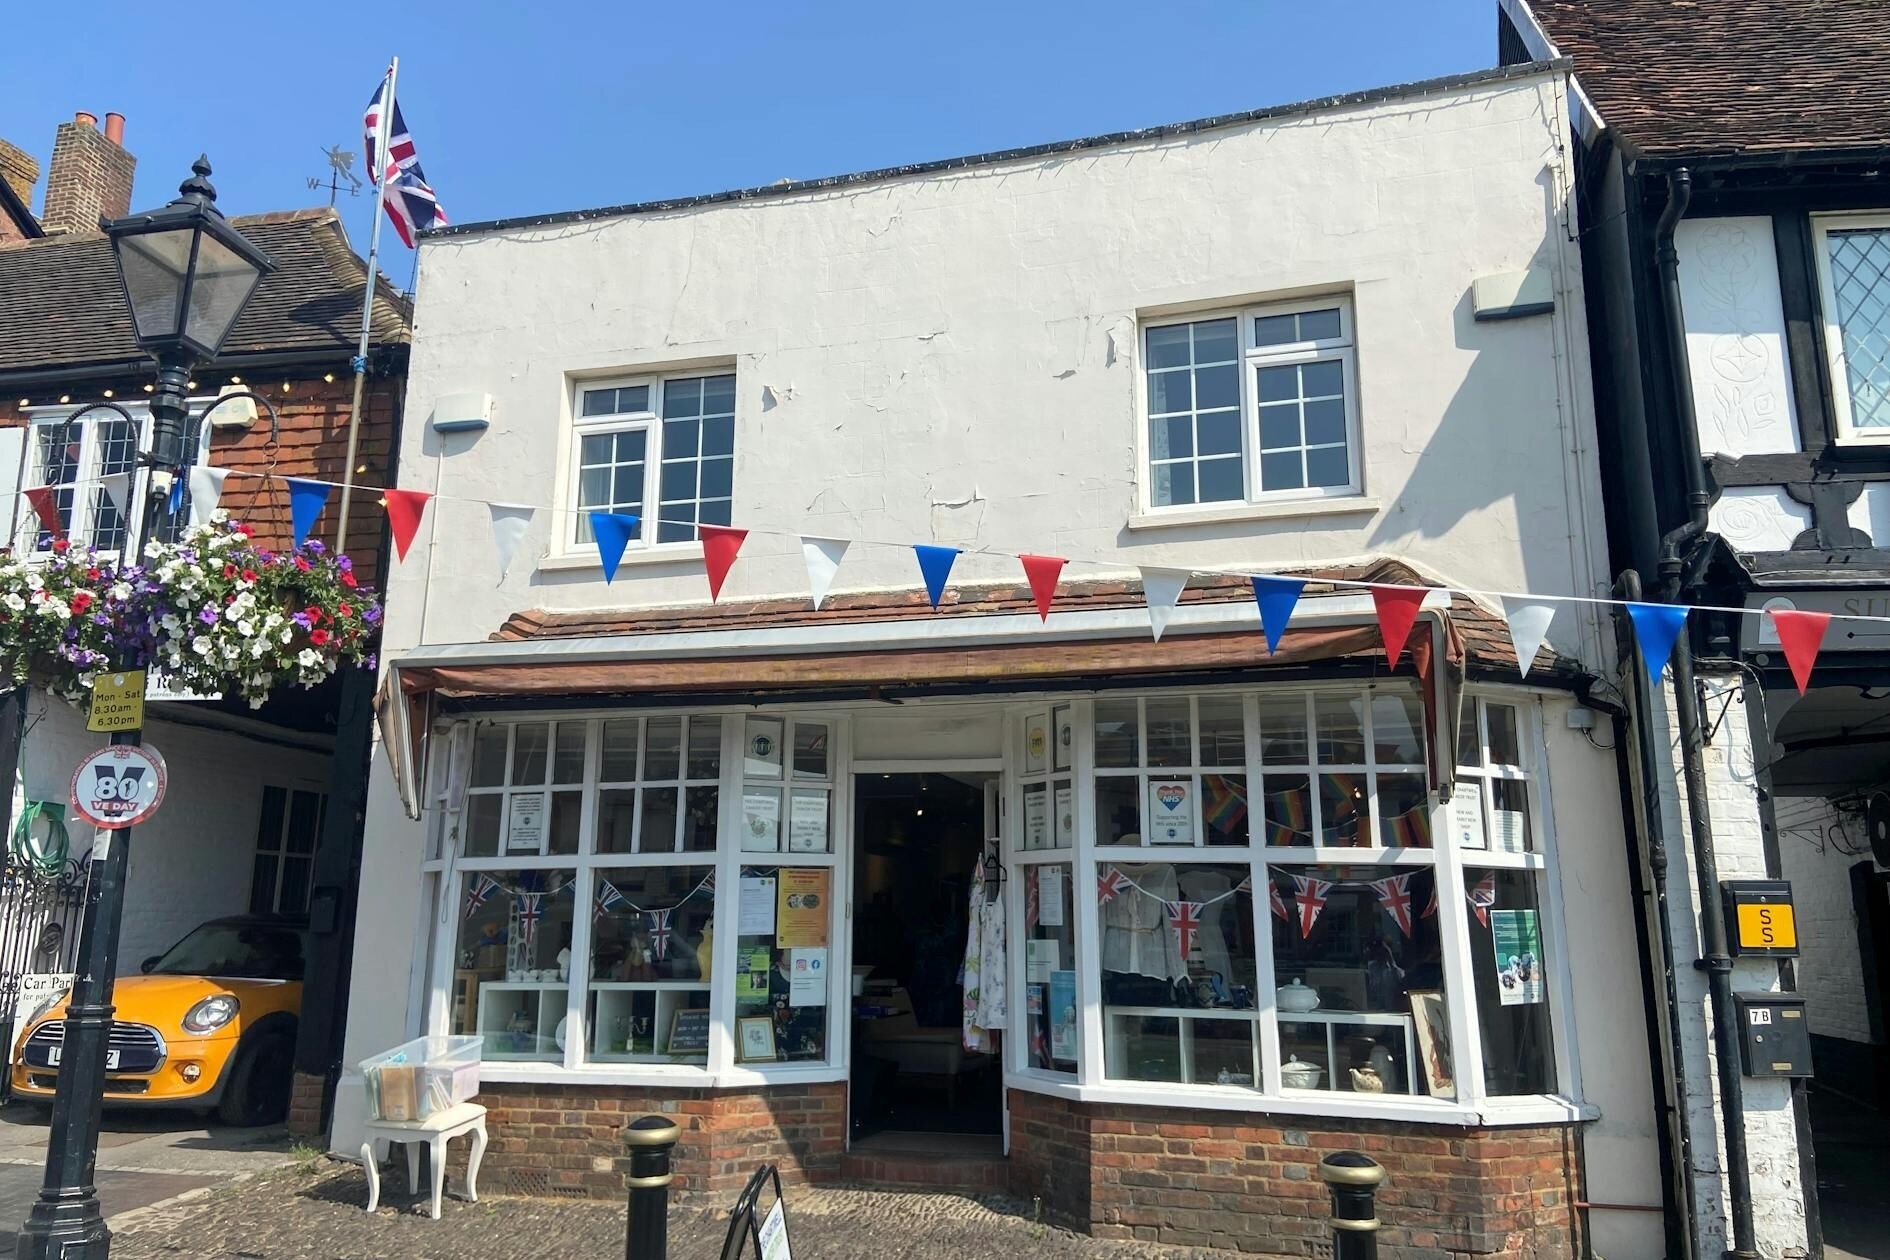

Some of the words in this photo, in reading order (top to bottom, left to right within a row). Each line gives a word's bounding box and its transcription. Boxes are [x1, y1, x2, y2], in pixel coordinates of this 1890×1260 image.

[96, 694, 115, 702] Mon
[124, 690, 140, 699] Sat
[94, 704, 131, 715] 8.30am
[97, 716, 135, 726] 6.30pm
[1162, 795, 1181, 803] NHS
[93, 801, 109, 810] VE
[112, 802, 136, 811] DAY
[24, 977, 46, 990] Car
